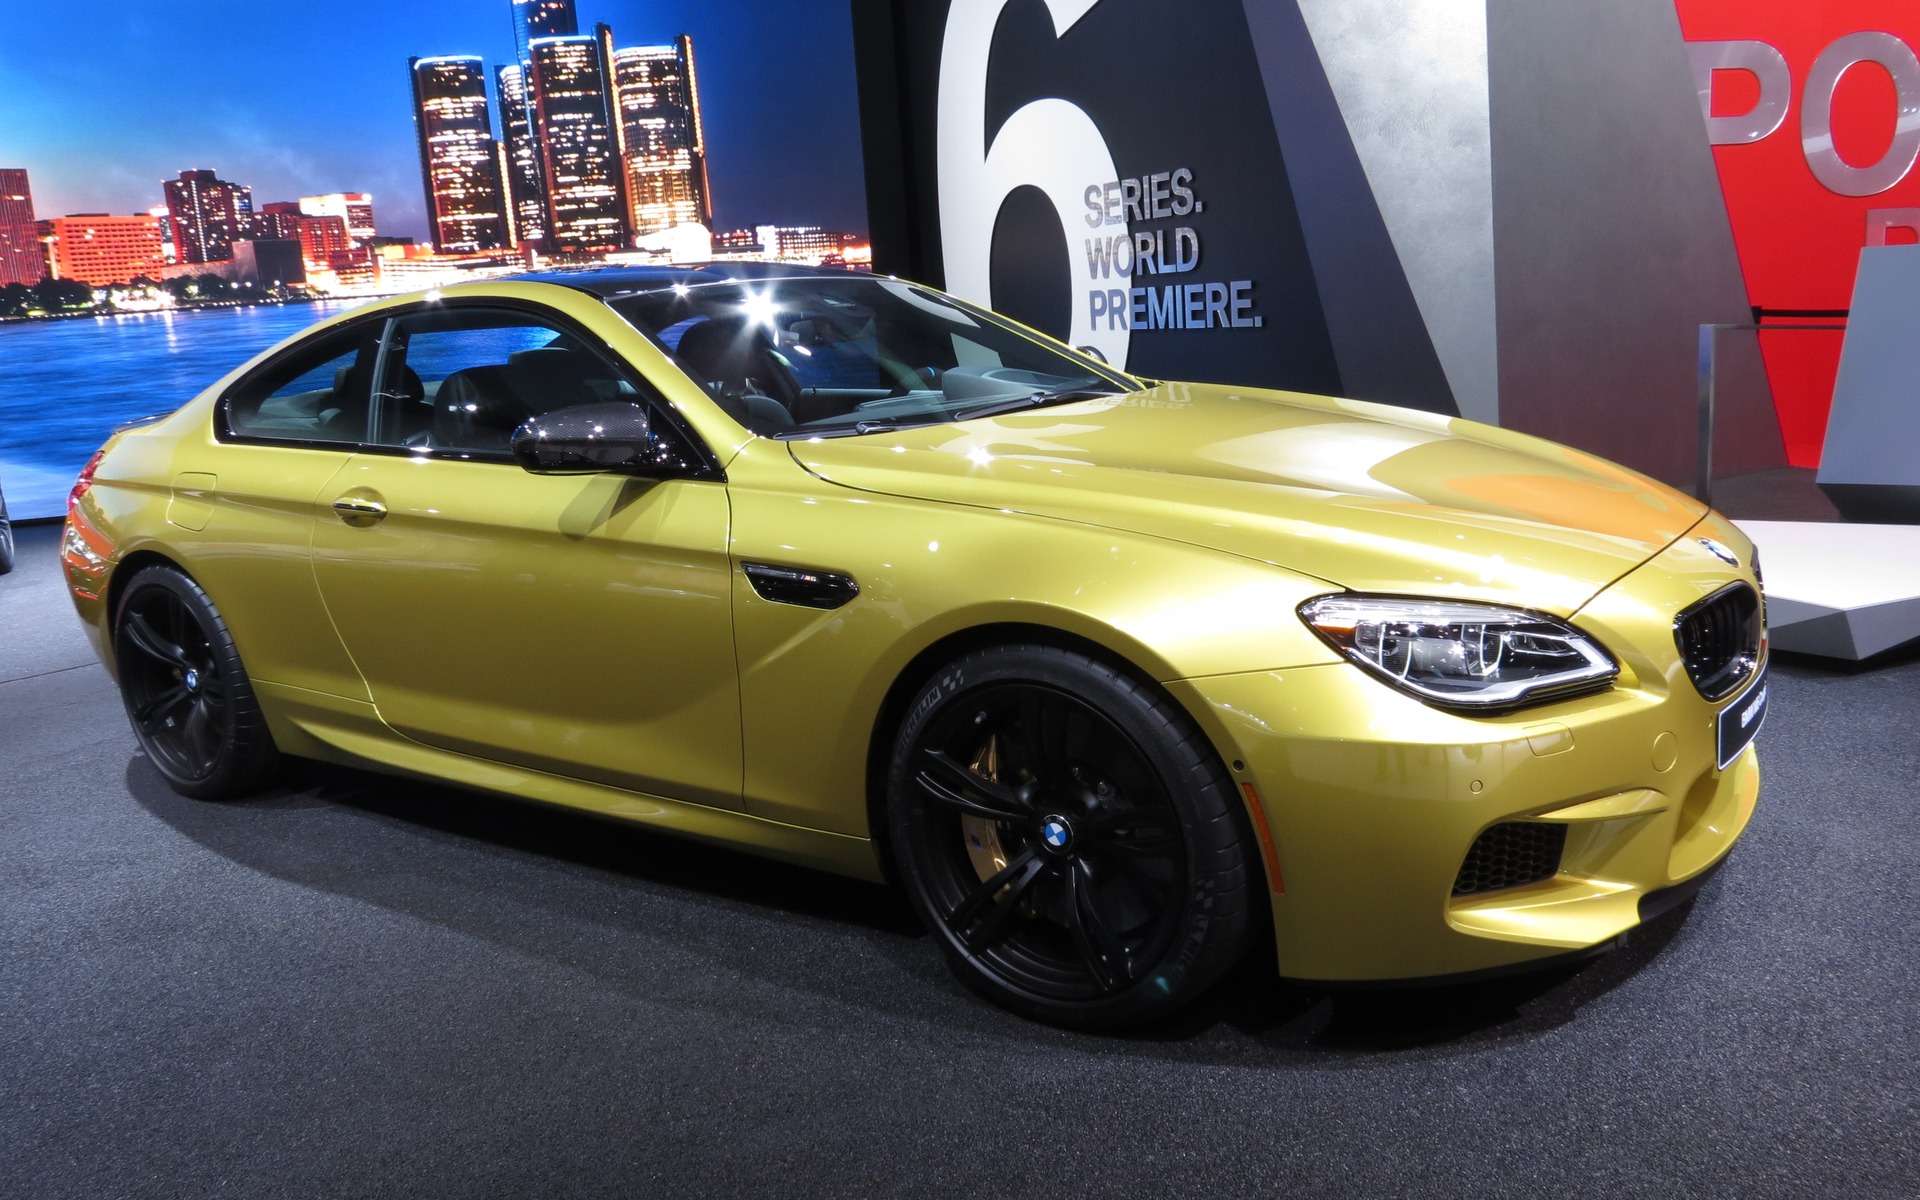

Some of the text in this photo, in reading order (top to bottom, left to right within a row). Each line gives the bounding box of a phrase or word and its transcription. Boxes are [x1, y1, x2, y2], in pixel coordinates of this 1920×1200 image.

[937, 0, 1132, 375] 6
[1084, 167, 1203, 228] SERIES.
[1085, 226, 1199, 280] WORLD
[1089, 280, 1263, 331] PREMIERE.
